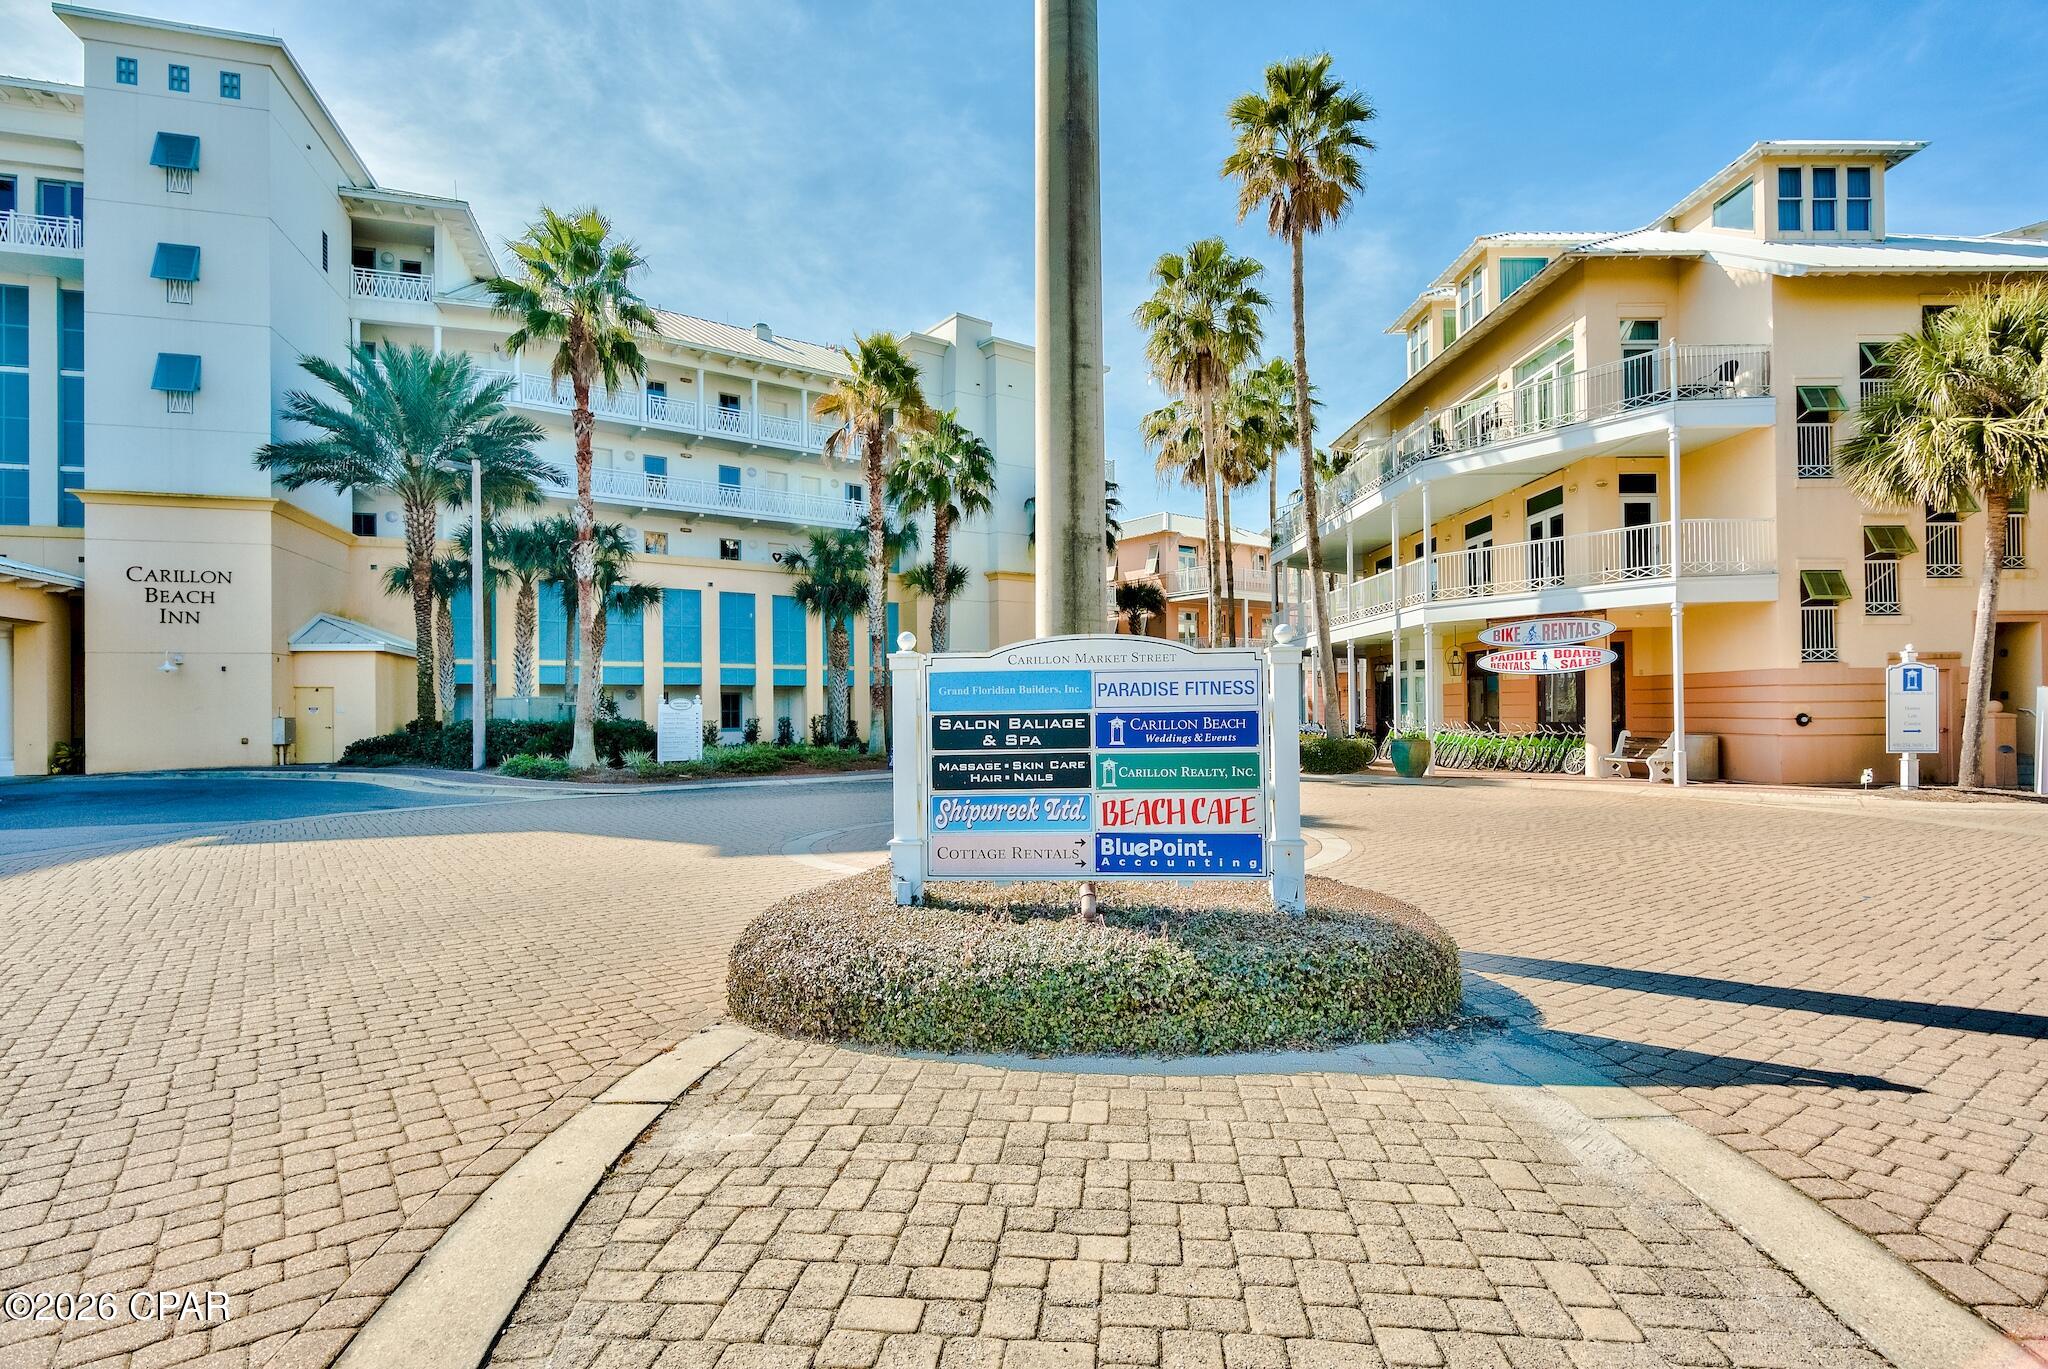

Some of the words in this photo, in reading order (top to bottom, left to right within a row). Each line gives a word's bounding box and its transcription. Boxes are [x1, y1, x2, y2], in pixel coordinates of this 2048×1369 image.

[126, 566, 232, 584] CARILLON
[144, 587, 216, 604] BEACH
[159, 608, 200, 624] INN
[1492, 626, 1521, 642] BIKE
[1542, 622, 1601, 642] RENTALS
[1008, 654, 1070, 666] CARILLON
[1074, 653, 1127, 664] MARKET
[1131, 652, 1176, 663] STREET
[1490, 650, 1537, 662] PADDLE
[1554, 648, 1601, 658] BOARD
[1490, 661, 1530, 671] RENTALS
[1560, 657, 1600, 669] SALES
[938, 686, 970, 696] Grand
[972, 685, 1016, 695] Floridian
[1019, 685, 1062, 695] Builders,
[1064, 684, 1082, 694] Inc.
[1098, 681, 1179, 697] PARADISE
[1186, 680, 1255, 696] FITNESS
[939, 718, 1000, 730] SALON
[1008, 717, 1086, 730] BALIAGE
[1130, 718, 1198, 730] CARILLON
[1203, 716, 1246, 729] BEACH
[982, 734, 997, 746] &
[1005, 734, 1042, 746] SPA
[1146, 734, 1192, 744] Weddings
[1194, 734, 1203, 742] &
[1205, 733, 1237, 742] Events
[938, 762, 1002, 772] MASSAGE
[1012, 761, 1044, 770] SKIN
[1050, 760, 1086, 769] CARE
[1118, 766, 1177, 778] CARILLON
[1180, 766, 1228, 779] REALTY,
[1231, 766, 1256, 777] INC.
[970, 774, 1002, 783] HAIR
[1014, 773, 1054, 782] NAILS
[935, 797, 1040, 830] Shipwreck
[1044, 796, 1088, 822] Ltd.
[1102, 798, 1186, 826] BEACH
[1191, 796, 1256, 824] CAFE
[937, 846, 1006, 860] COTTAGE
[1012, 846, 1080, 860] RENTALS
[1101, 838, 1212, 857] BluePoint.
[1101, 857, 1258, 868] Accounting
